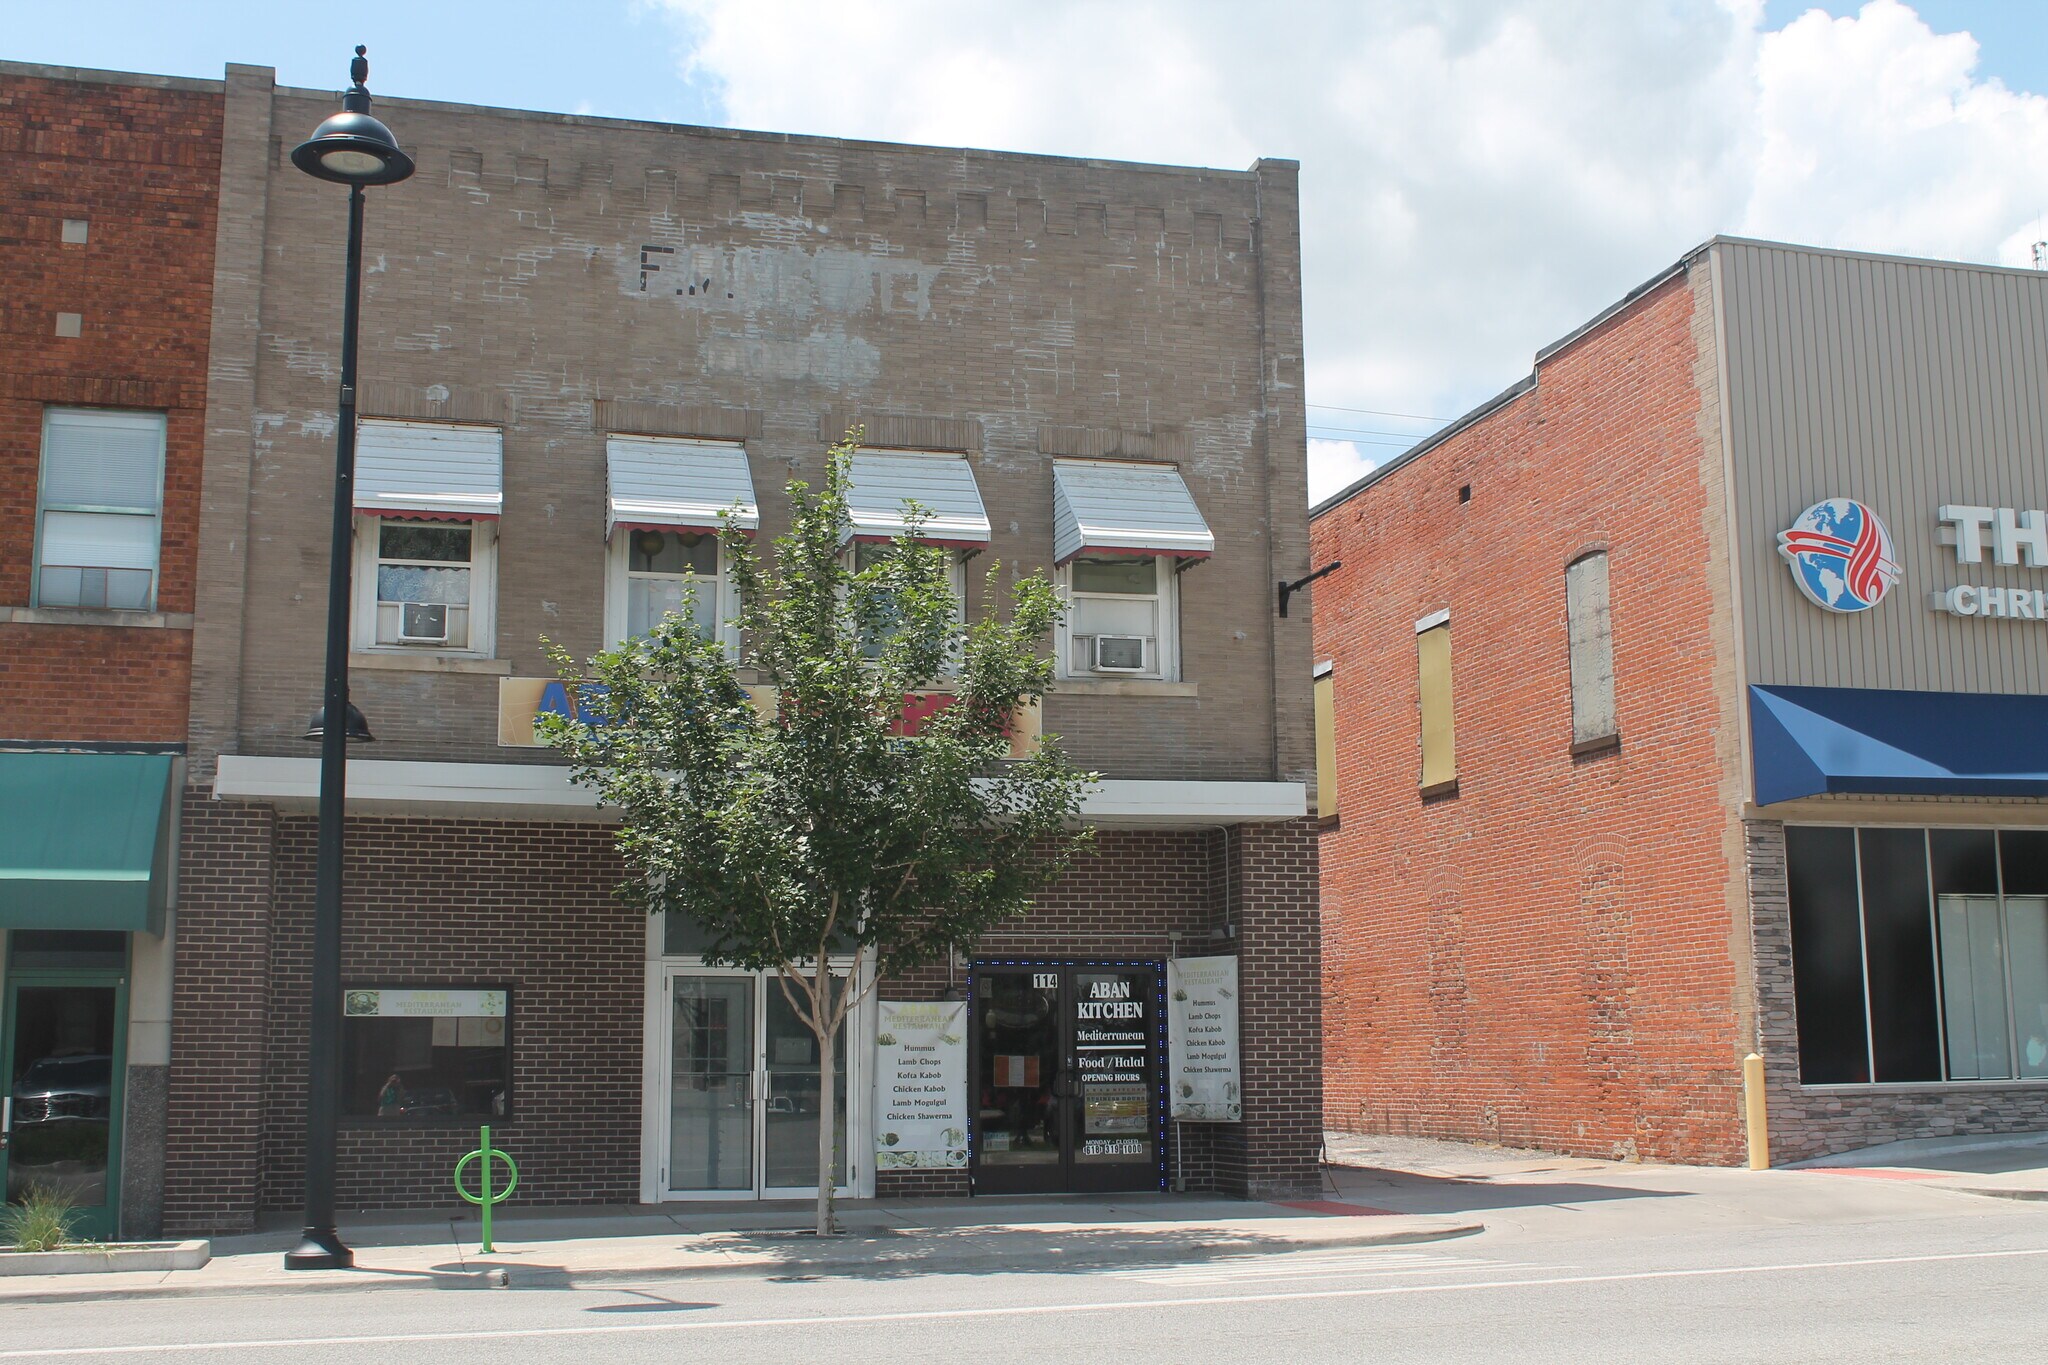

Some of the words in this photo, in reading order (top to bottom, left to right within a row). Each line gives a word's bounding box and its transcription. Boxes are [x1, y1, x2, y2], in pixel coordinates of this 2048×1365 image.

[1939, 504, 2048, 568] TH
[1946, 584, 2048, 619] CHRI
[1034, 974, 1057, 988] 114
[1090, 982, 1130, 998] ABAN
[1077, 1002, 1142, 1018] KITCHEN
[1077, 1029, 1144, 1040] Mediterranean
[1078, 1057, 1104, 1068] Food
[1082, 1074, 1114, 1082] OPENING
[1114, 1074, 1140, 1082] HOURS
